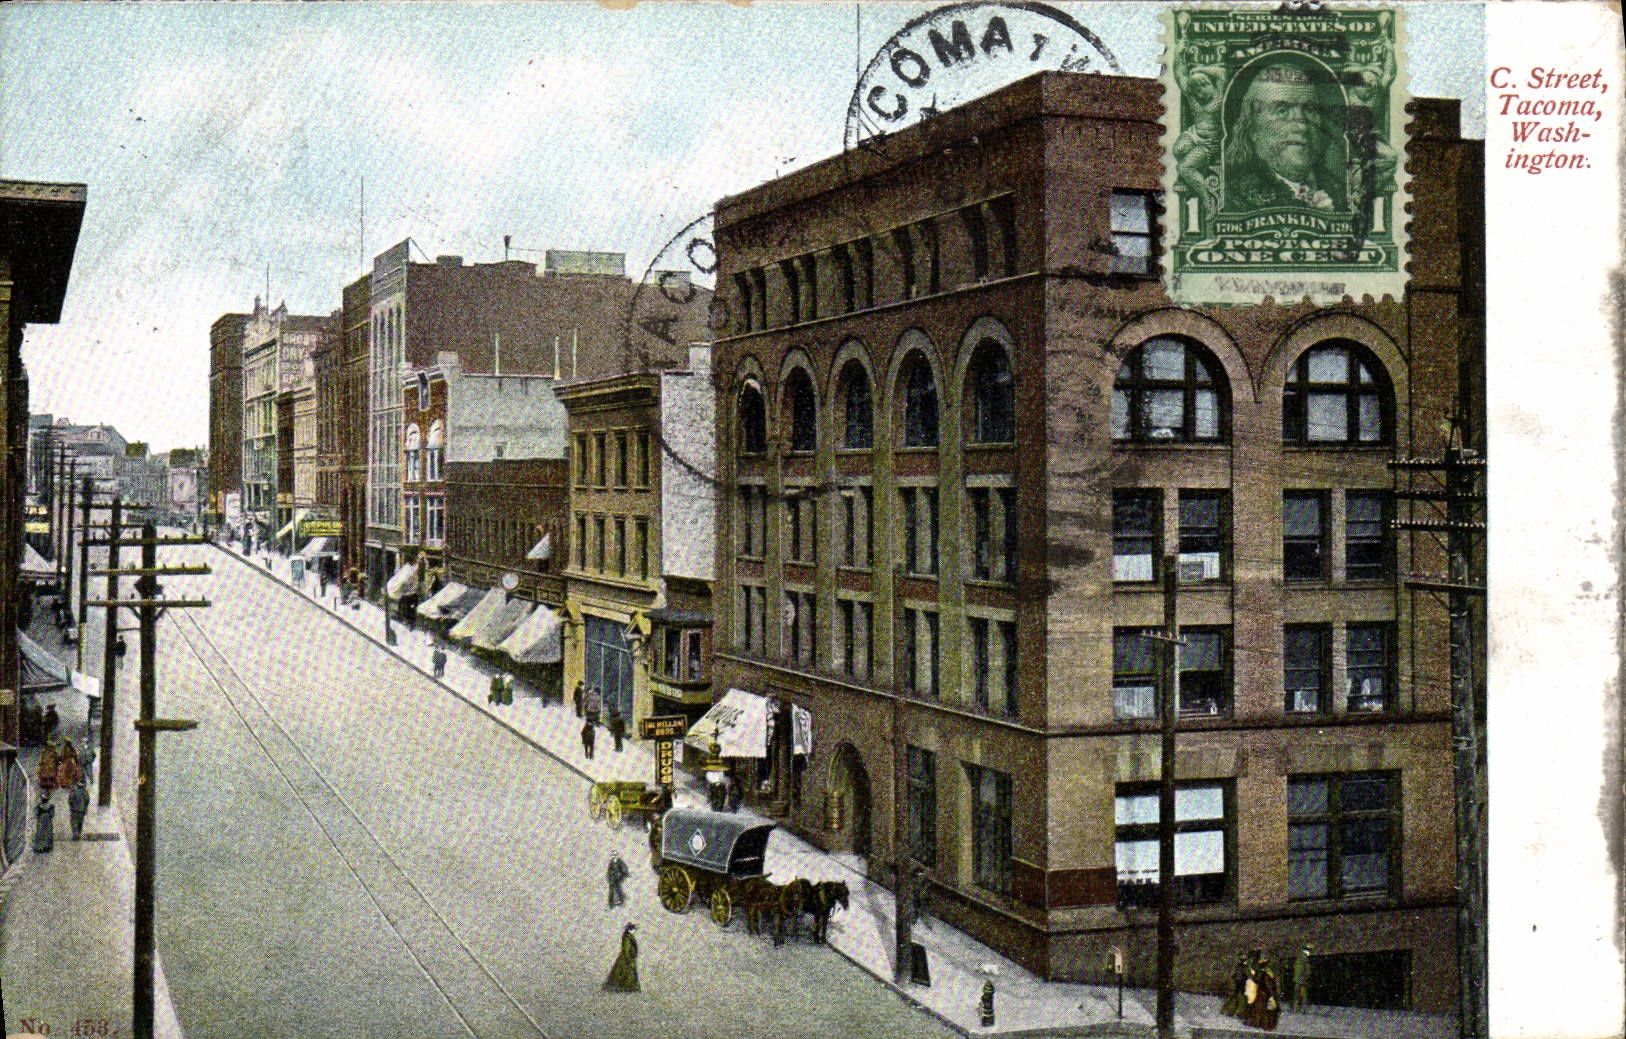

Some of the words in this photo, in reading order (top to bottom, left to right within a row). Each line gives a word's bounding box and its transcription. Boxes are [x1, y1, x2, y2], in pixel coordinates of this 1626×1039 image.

[1193, 22, 1267, 33] UNITED
[1269, 22, 1347, 33] STATES
[1349, 22, 1376, 33] OF
[1185, 197, 1201, 232] 1
[1215, 222, 1243, 233] 1706
[1246, 214, 1328, 232] FRANKLIN
[1372, 197, 1386, 232] 1
[1224, 239, 1349, 249] POSTAGE
[1197, 250, 1274, 262] ONE
[660, 741, 673, 784] DRUGS
